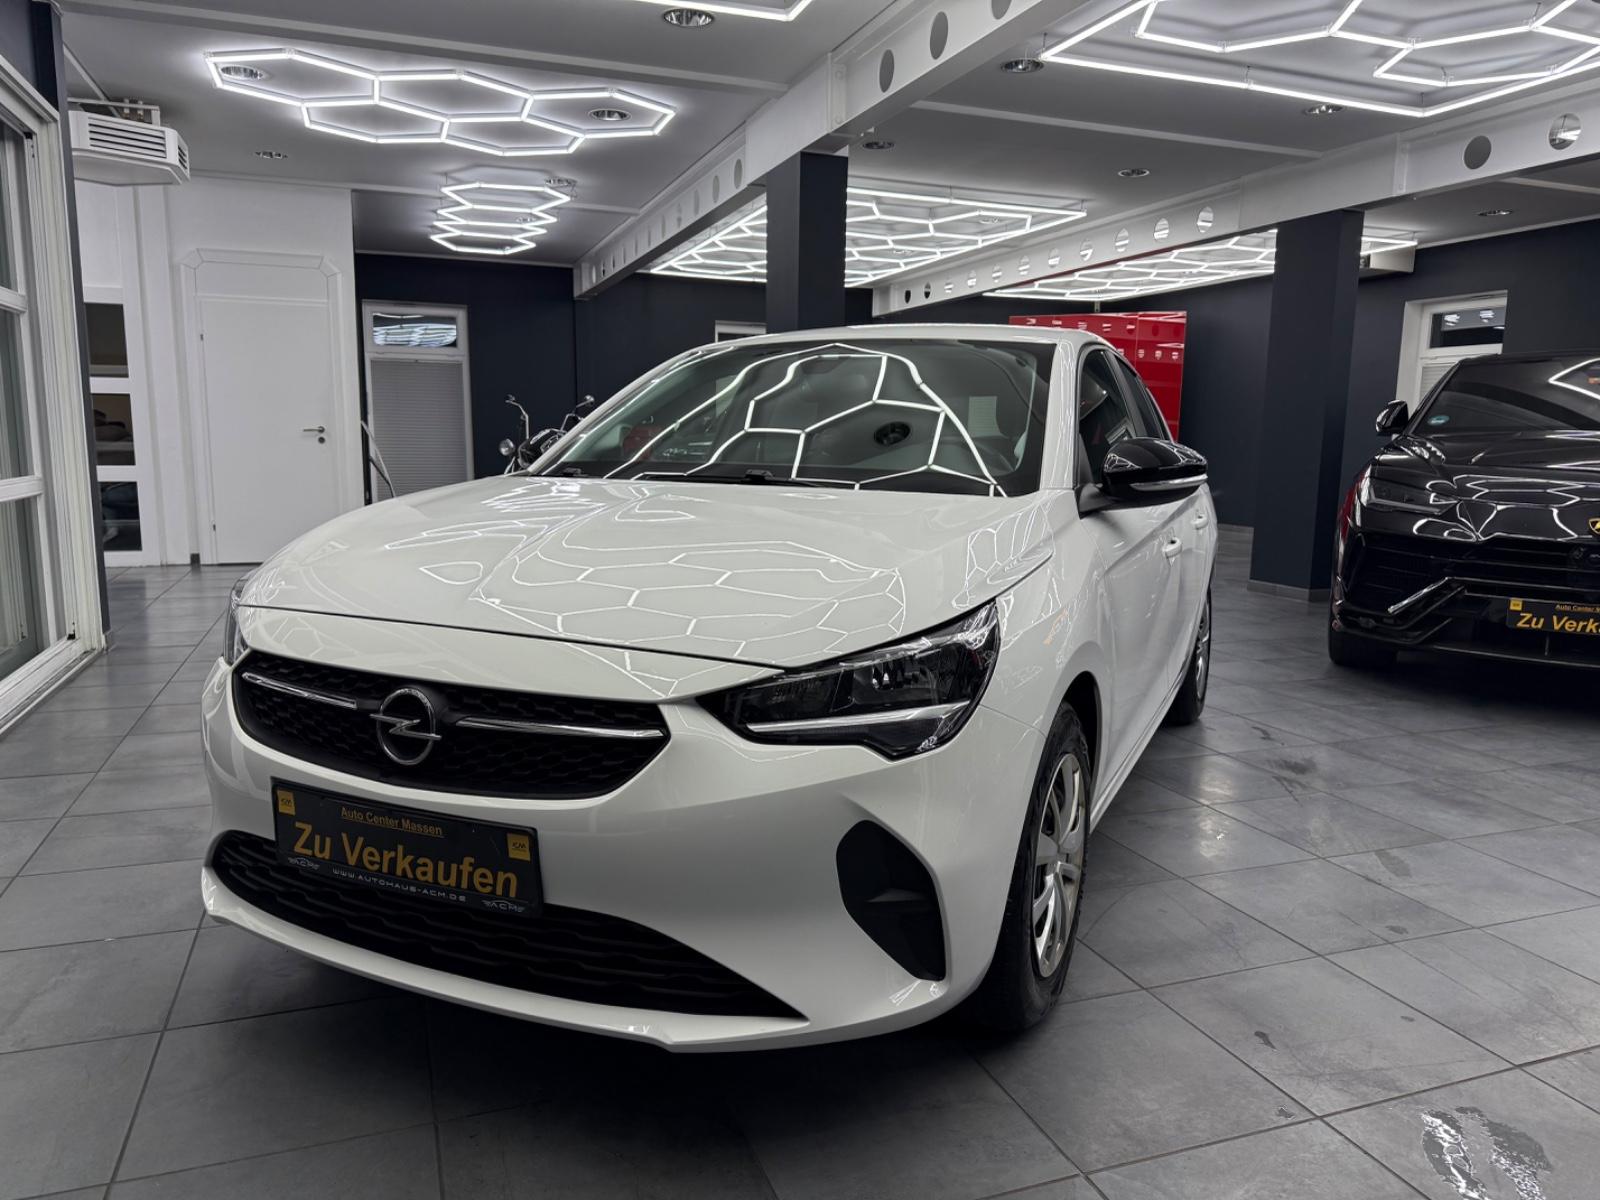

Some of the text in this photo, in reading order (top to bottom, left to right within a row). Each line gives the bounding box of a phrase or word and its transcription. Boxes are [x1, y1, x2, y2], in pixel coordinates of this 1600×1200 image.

[1516, 612, 1600, 634] Zu Verk
[340, 807, 444, 836] Auto Center Massen
[294, 821, 518, 898] Zu Verkaufen
